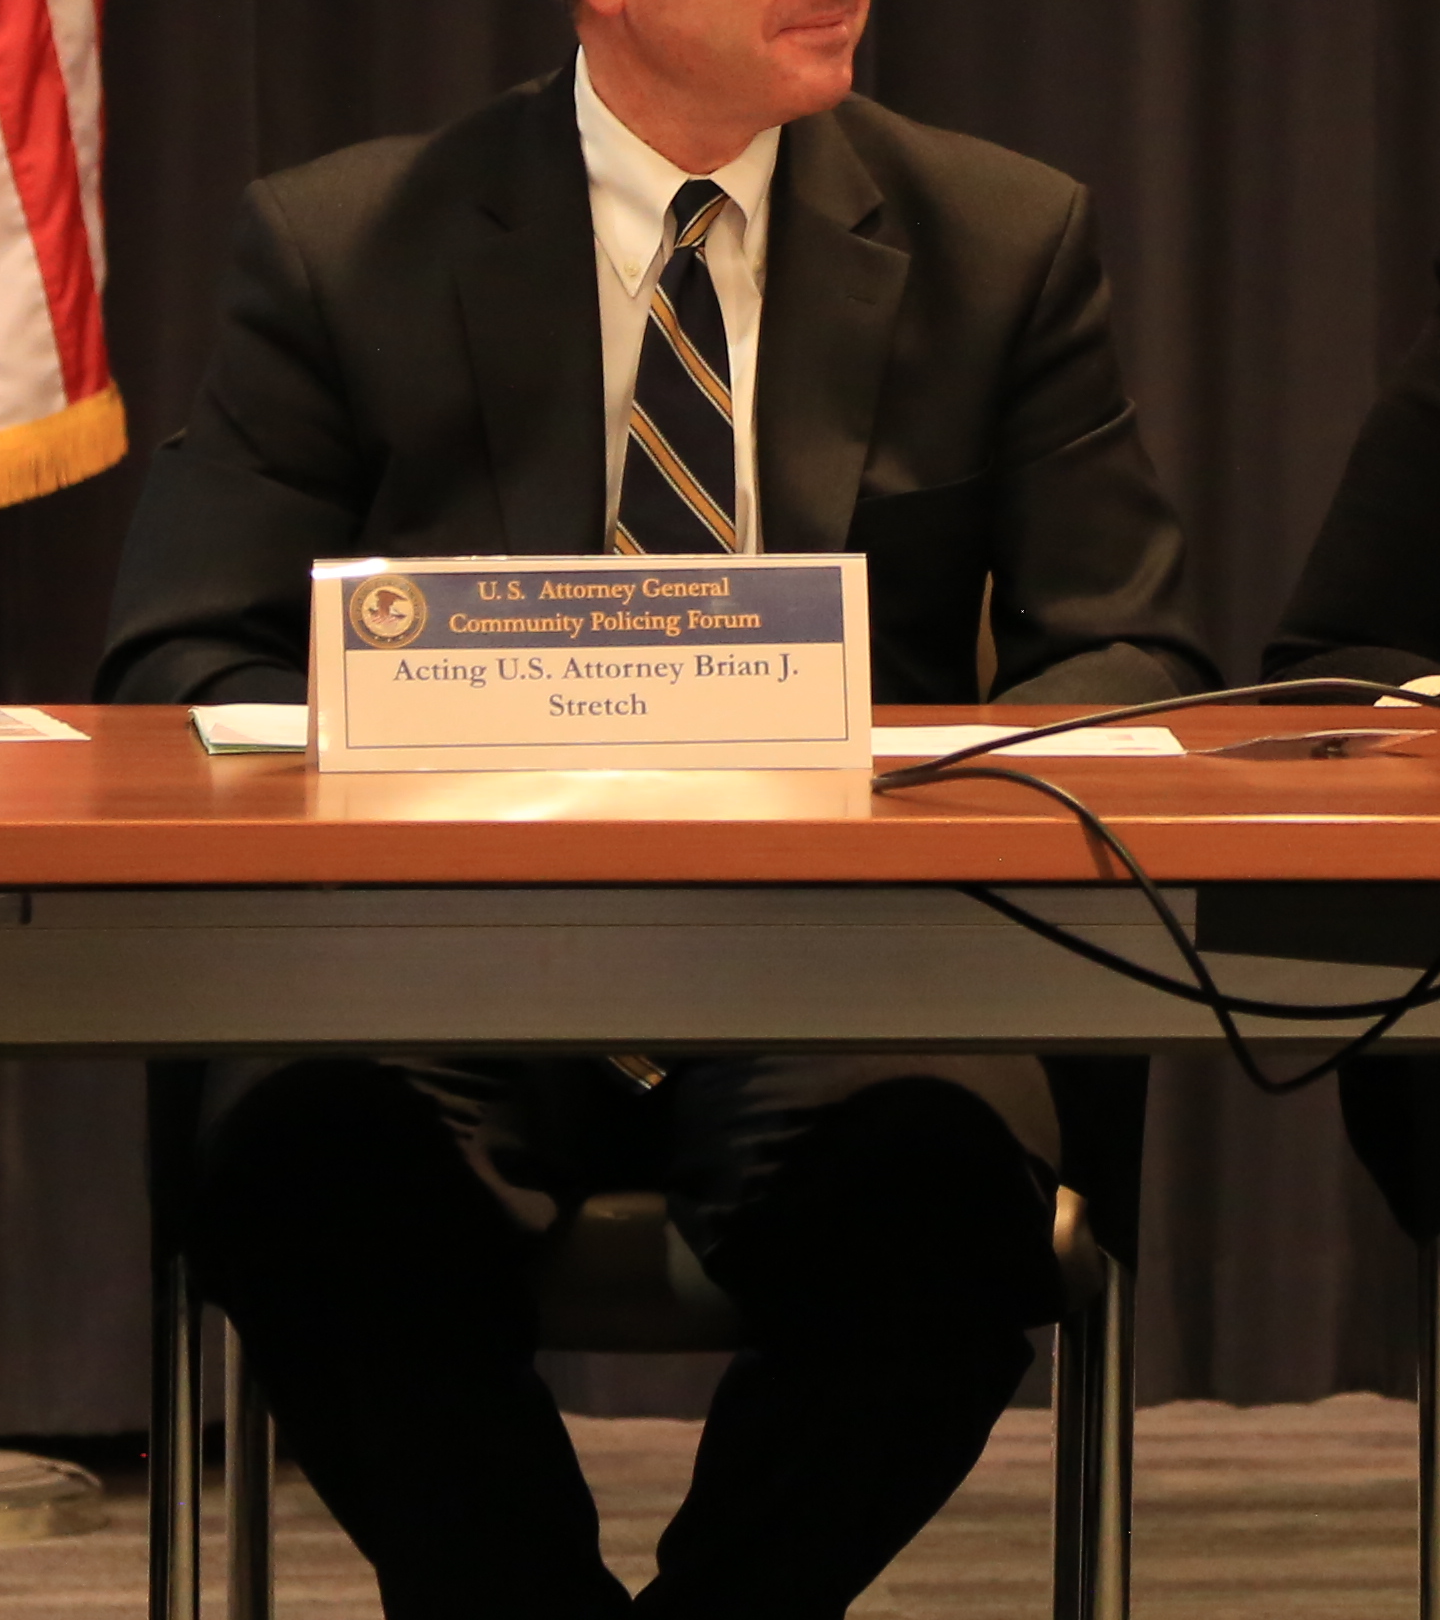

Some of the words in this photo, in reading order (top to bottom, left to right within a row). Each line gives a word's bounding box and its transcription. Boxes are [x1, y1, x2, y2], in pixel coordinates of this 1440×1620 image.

[539, 580, 638, 604] Attorney
[642, 578, 729, 598] General
[449, 613, 587, 638] Community
[590, 611, 681, 636] Policing
[687, 610, 762, 631] Forum
[393, 659, 487, 688] Acting
[496, 658, 552, 681] U.S.
[562, 656, 685, 685] Attorney
[694, 654, 771, 677] Brian
[776, 653, 799, 683] J.
[548, 693, 648, 717] Stretch
